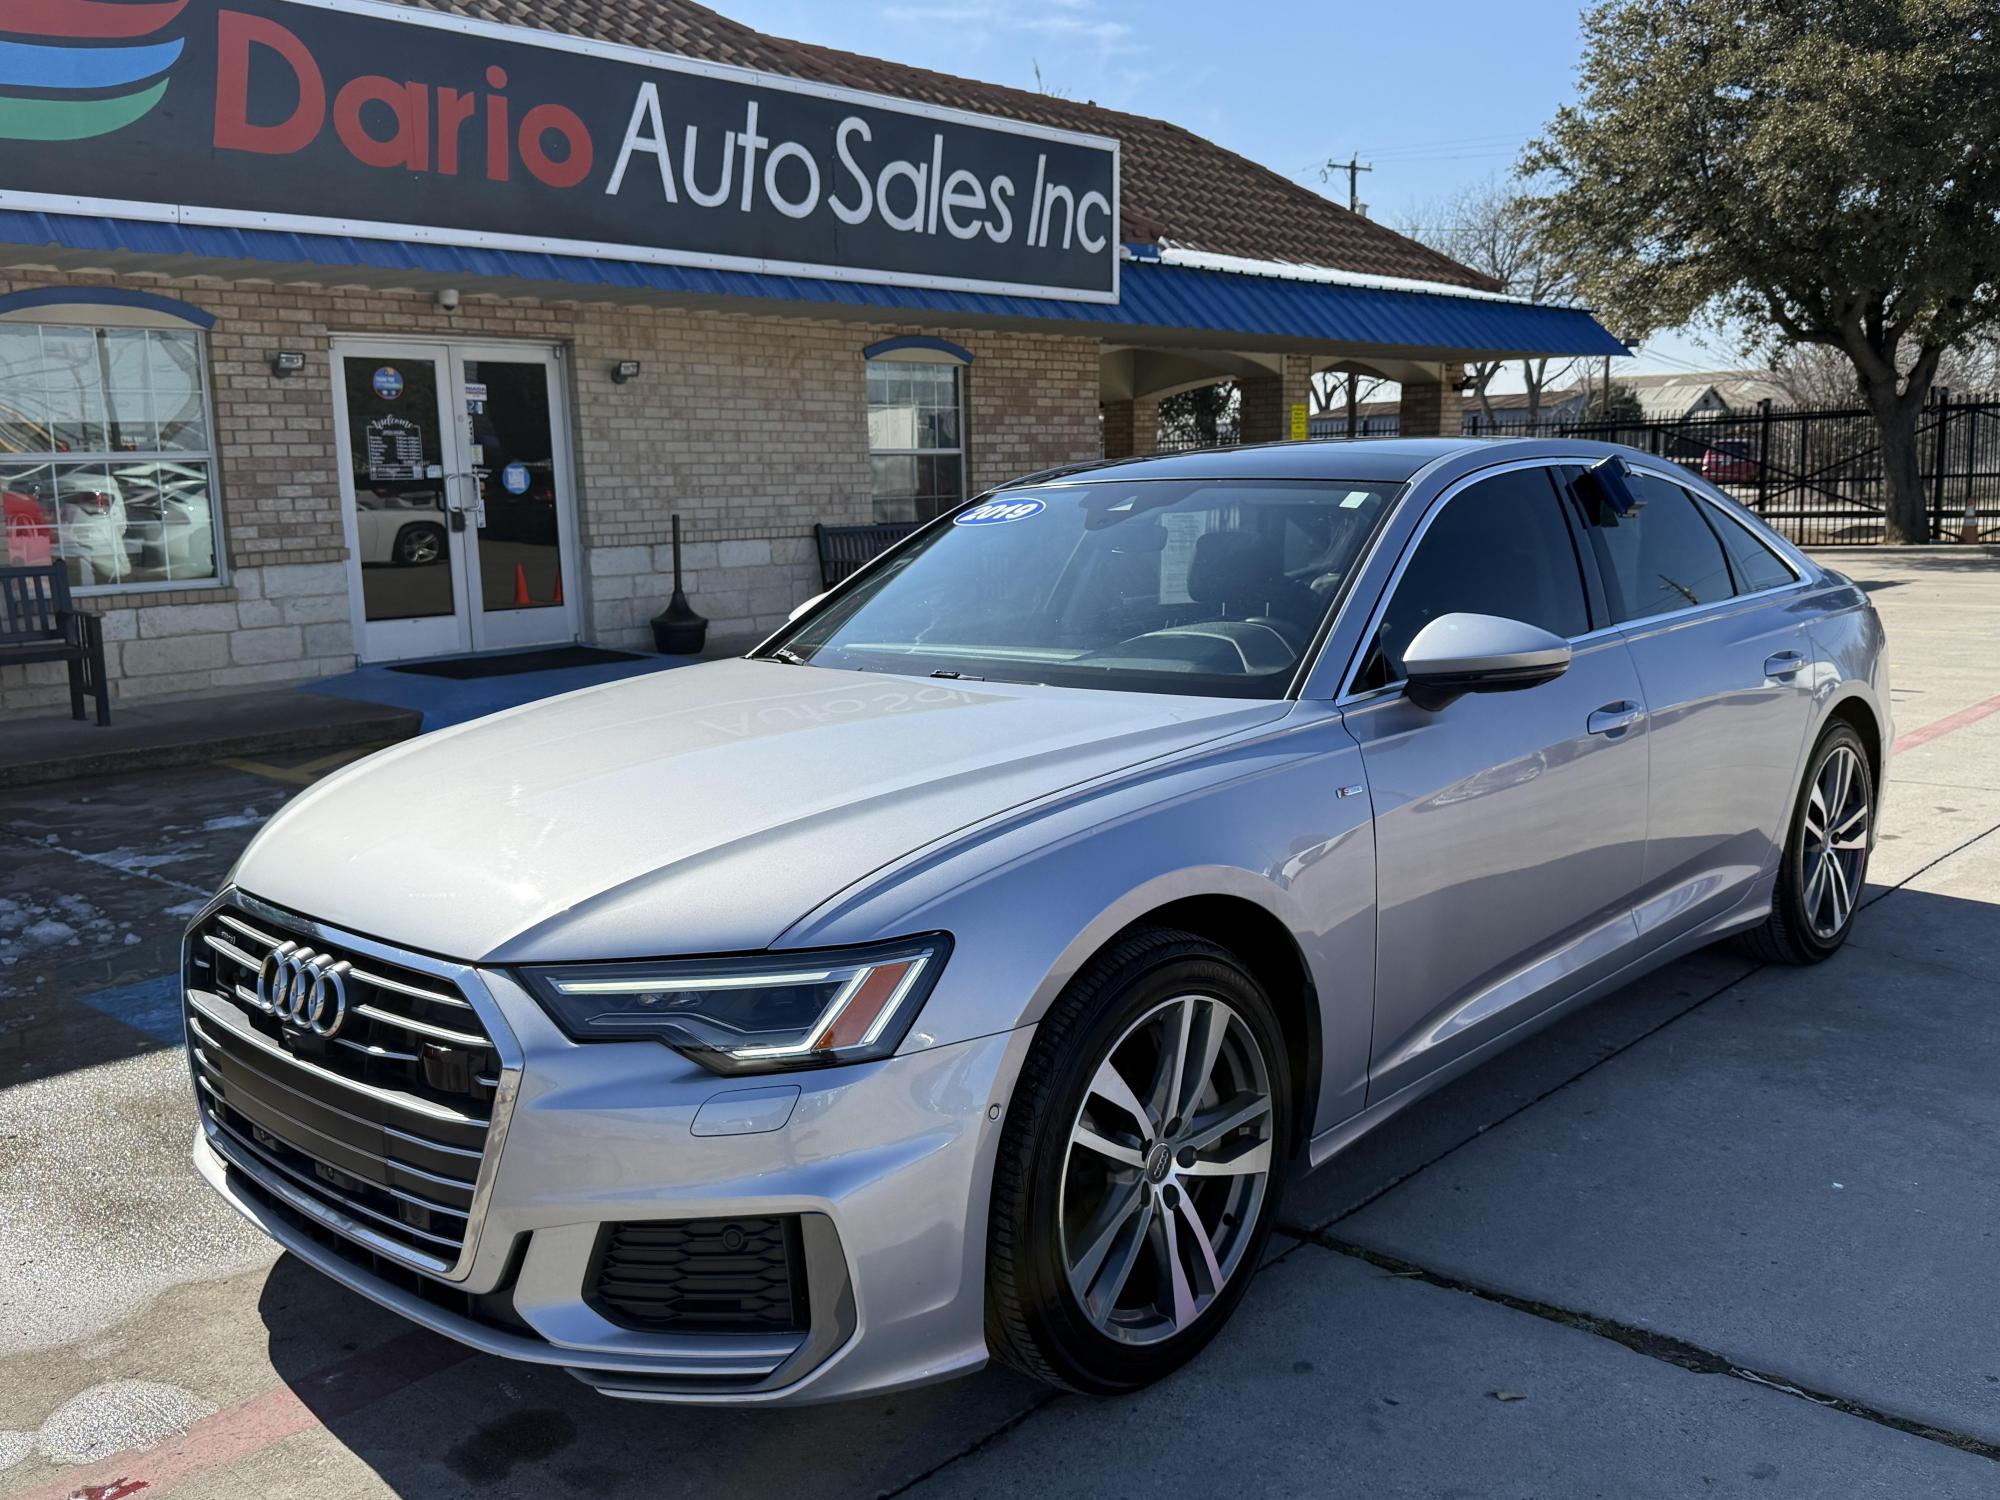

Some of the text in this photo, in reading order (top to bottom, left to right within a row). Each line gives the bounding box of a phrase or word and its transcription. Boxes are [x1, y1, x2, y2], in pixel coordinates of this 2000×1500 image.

[213, 9, 1112, 254] Dario Auto Sales Inc
[372, 414, 414, 430] Welcome
[957, 503, 1039, 523] 2019
